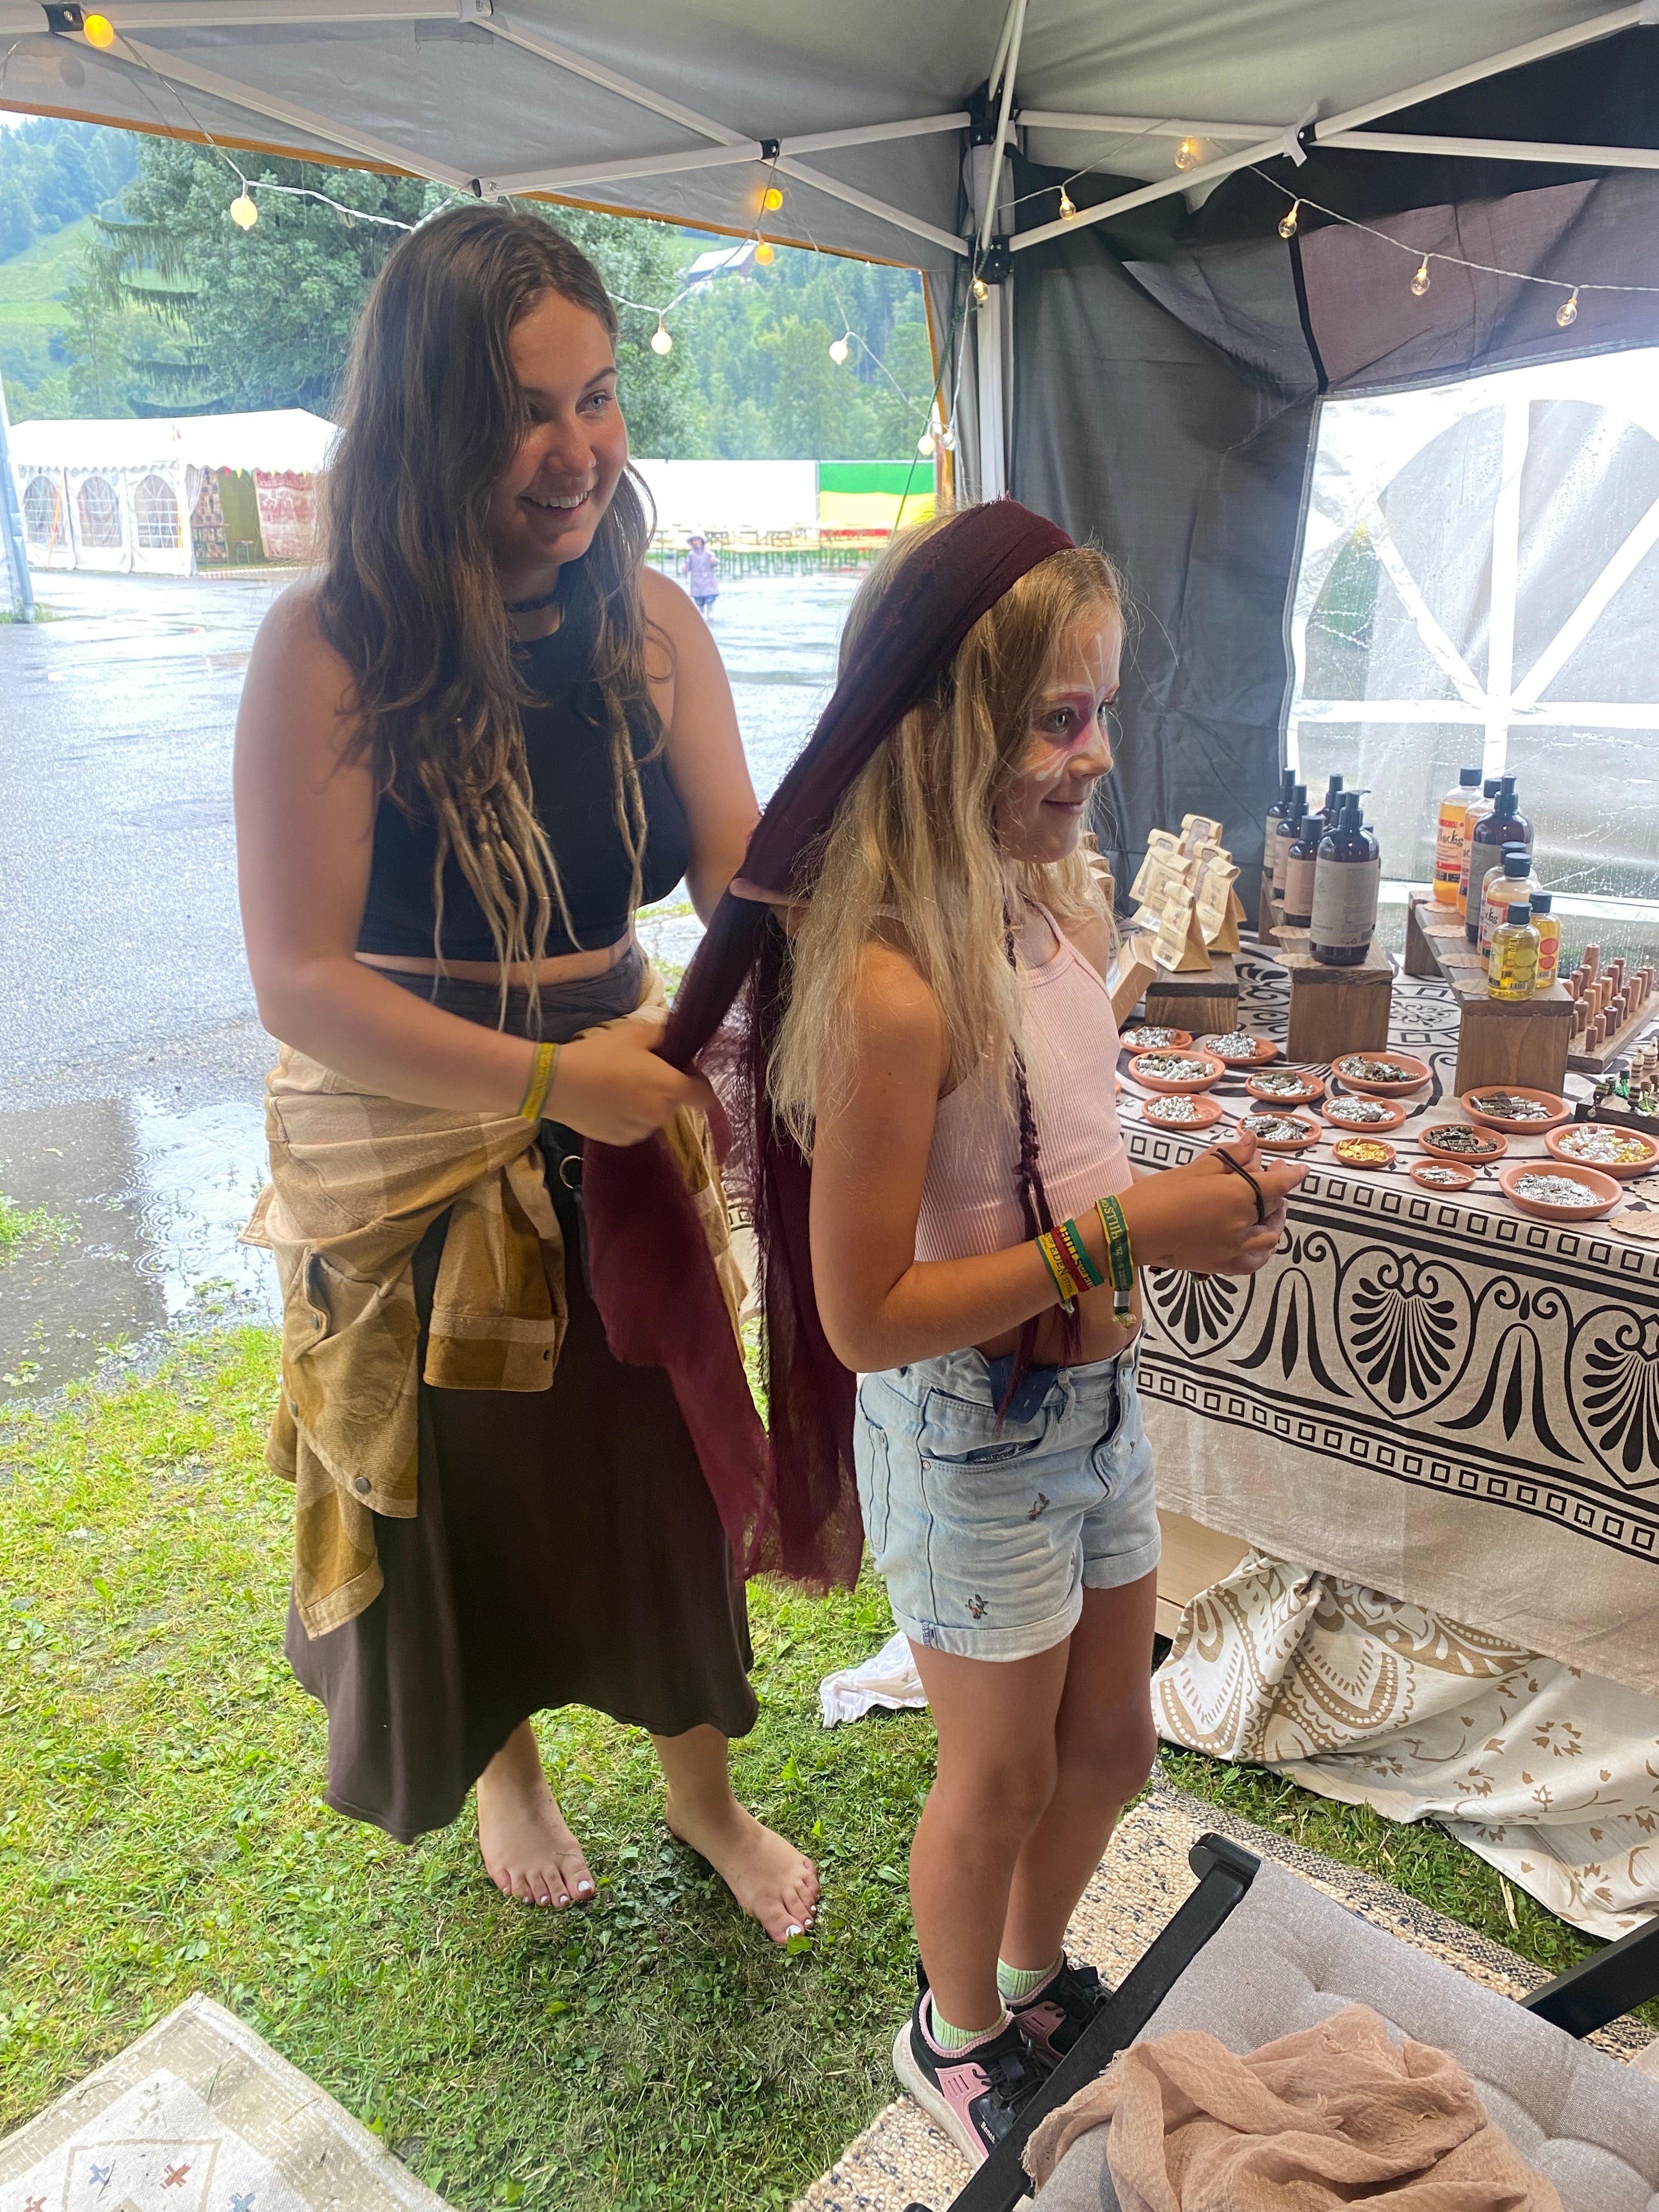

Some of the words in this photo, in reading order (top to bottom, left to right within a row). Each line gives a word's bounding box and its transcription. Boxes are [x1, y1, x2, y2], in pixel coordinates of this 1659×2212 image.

[1104, 1207, 1124, 1240] HILLS
[1049, 1245, 1069, 1277] EDEN
[1058, 1229, 1083, 1266] HILLS
